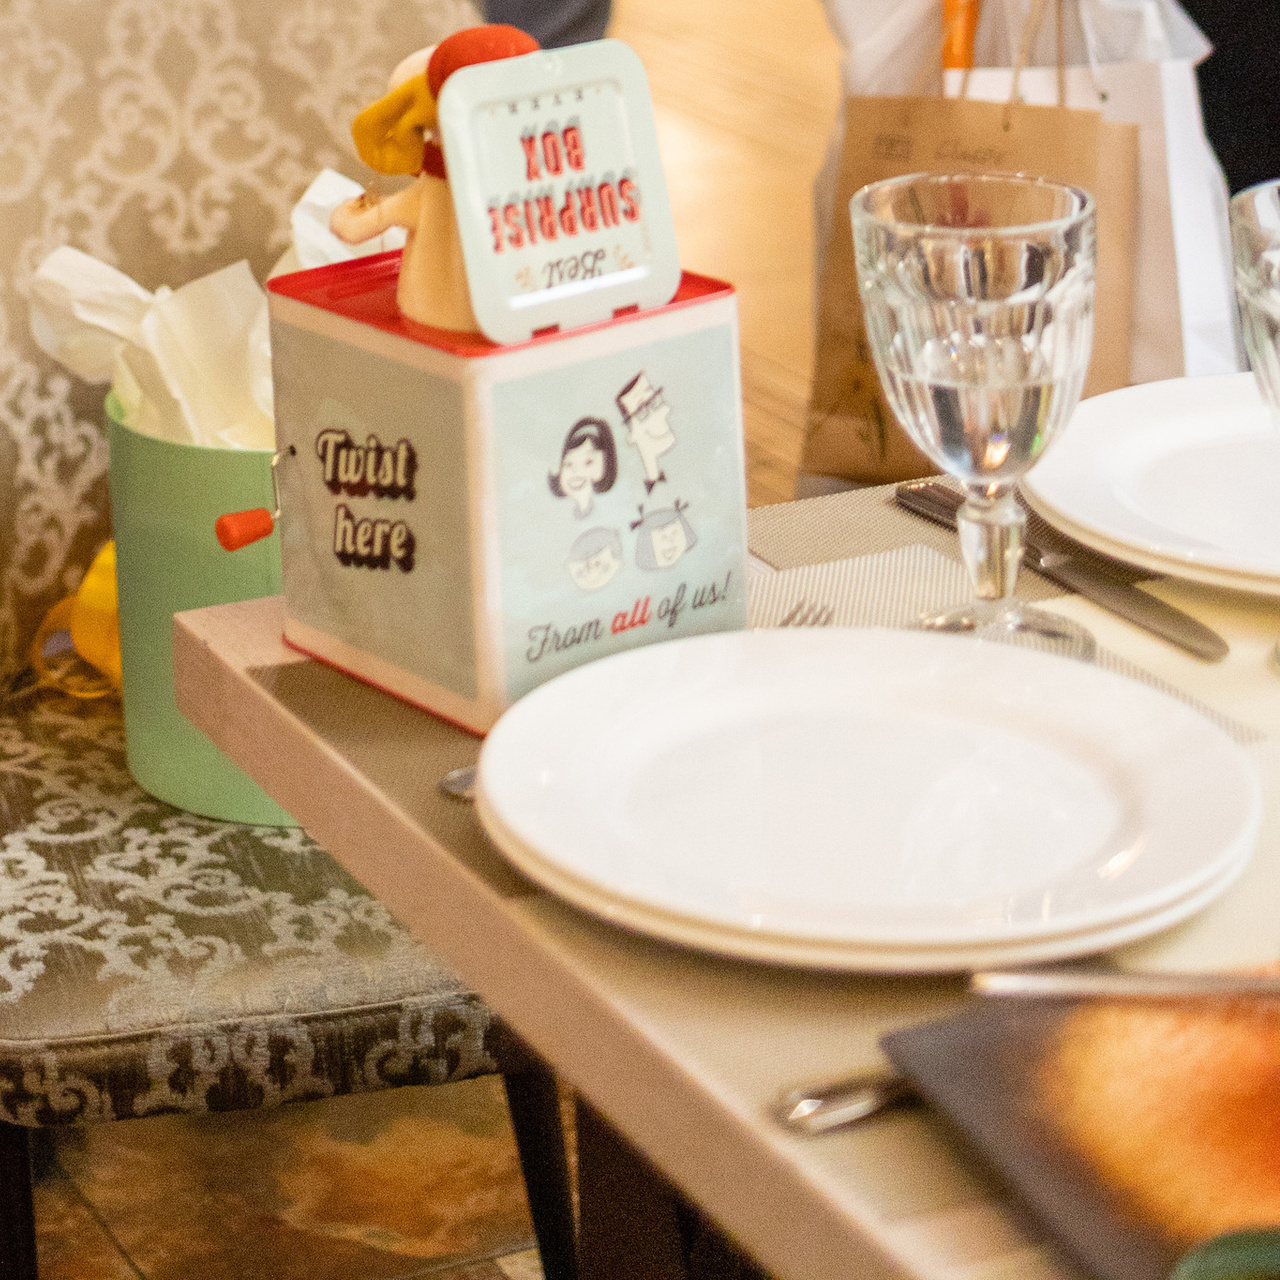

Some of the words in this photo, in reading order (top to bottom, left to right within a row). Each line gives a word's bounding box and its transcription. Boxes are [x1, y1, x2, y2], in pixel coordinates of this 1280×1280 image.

[520, 124, 586, 182] BOX
[487, 176, 641, 255] SURPRISE
[541, 248, 607, 289] Best
[316, 428, 418, 502] Twist
[334, 502, 417, 574] here
[525, 616, 603, 664] From
[610, 595, 653, 635] all
[656, 580, 689, 629] of
[690, 570, 733, 611] us!
